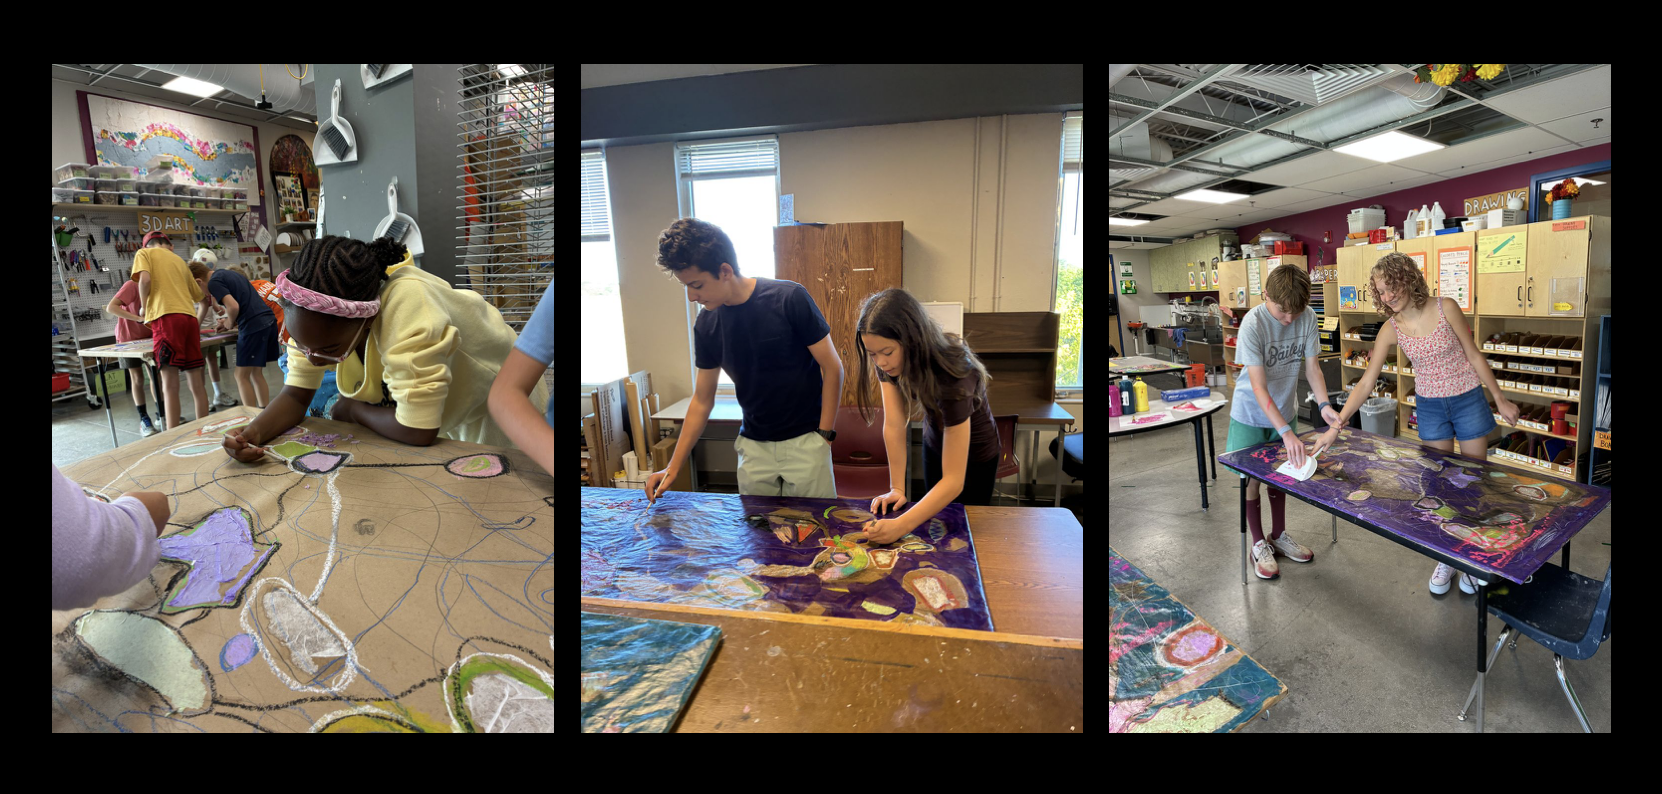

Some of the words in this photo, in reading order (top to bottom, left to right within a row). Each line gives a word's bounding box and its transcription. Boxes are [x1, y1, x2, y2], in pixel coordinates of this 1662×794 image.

[1464, 190, 1527, 217] DRAWING
[141, 214, 163, 233] 3D
[165, 216, 191, 231] ART
